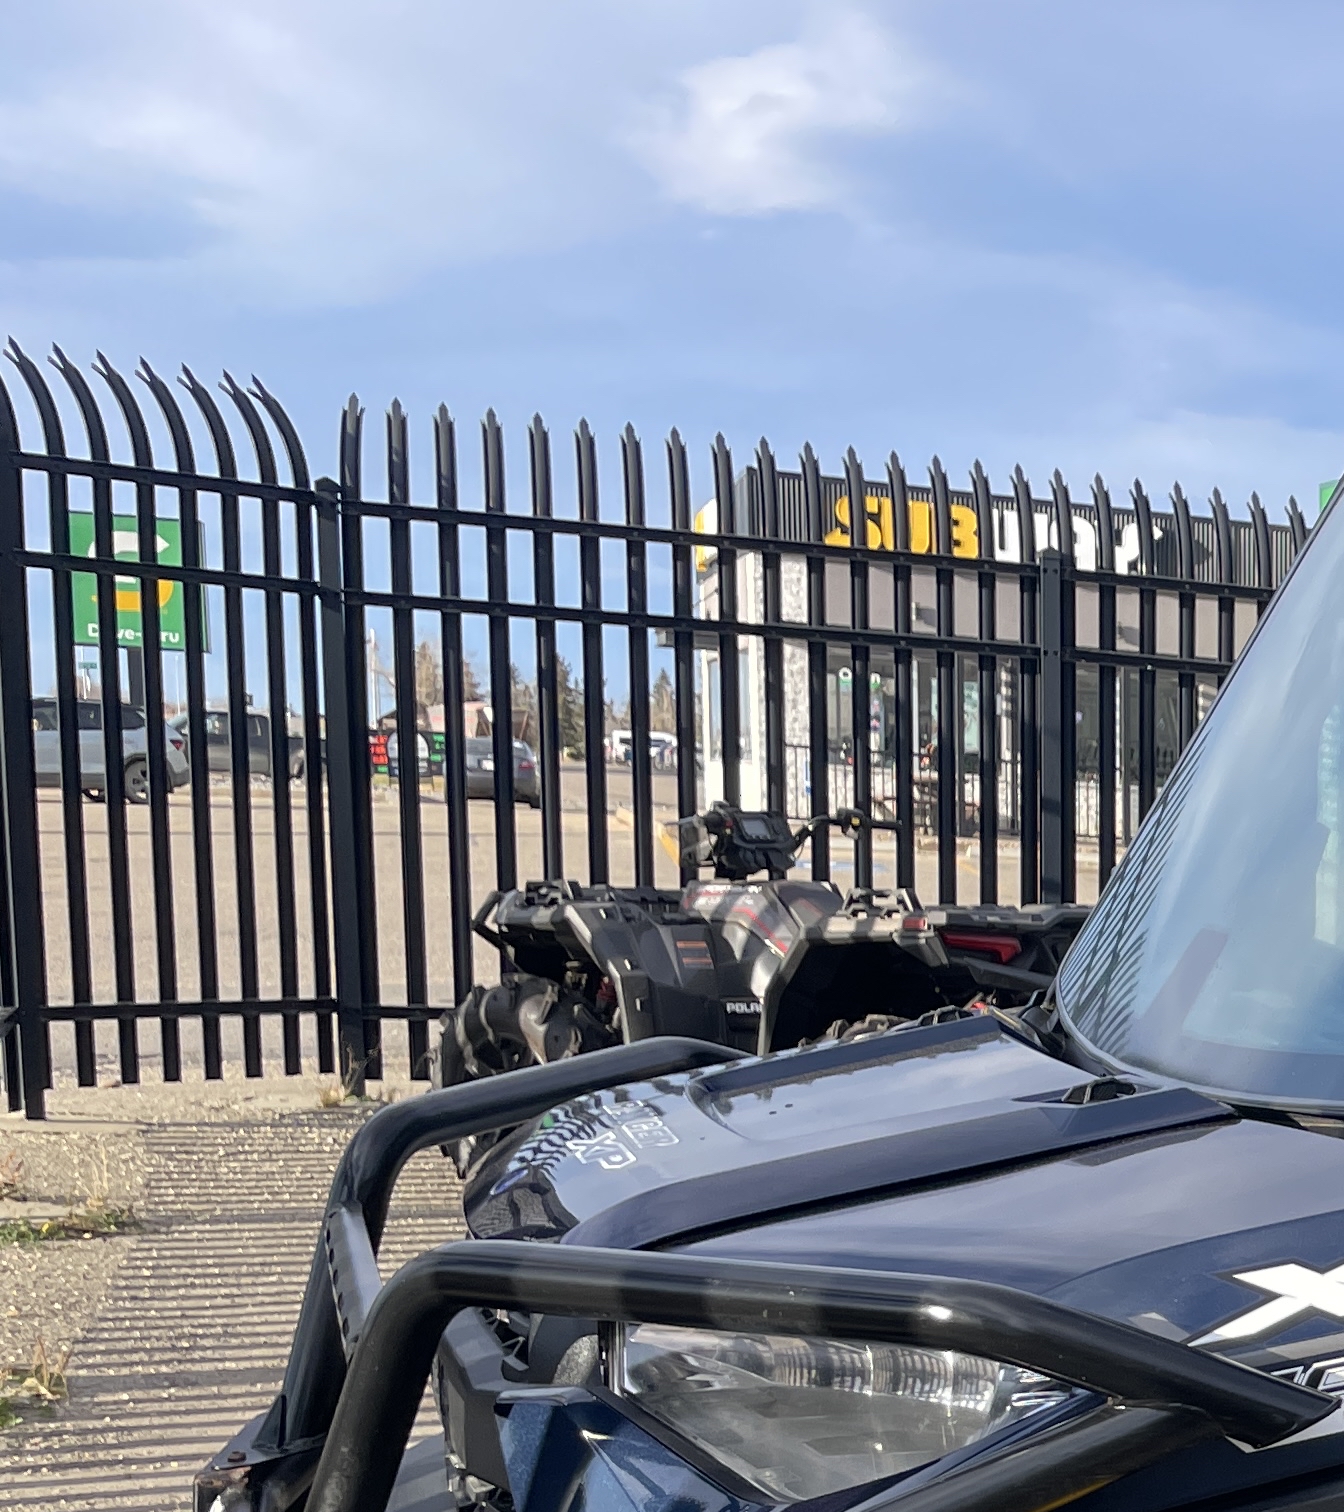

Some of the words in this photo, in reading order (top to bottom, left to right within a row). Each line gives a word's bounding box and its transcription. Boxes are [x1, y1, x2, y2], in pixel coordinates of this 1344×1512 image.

[87, 622, 181, 644] Dve-ru
[726, 1002, 762, 1015] POLA
[565, 1131, 637, 1170] XP
